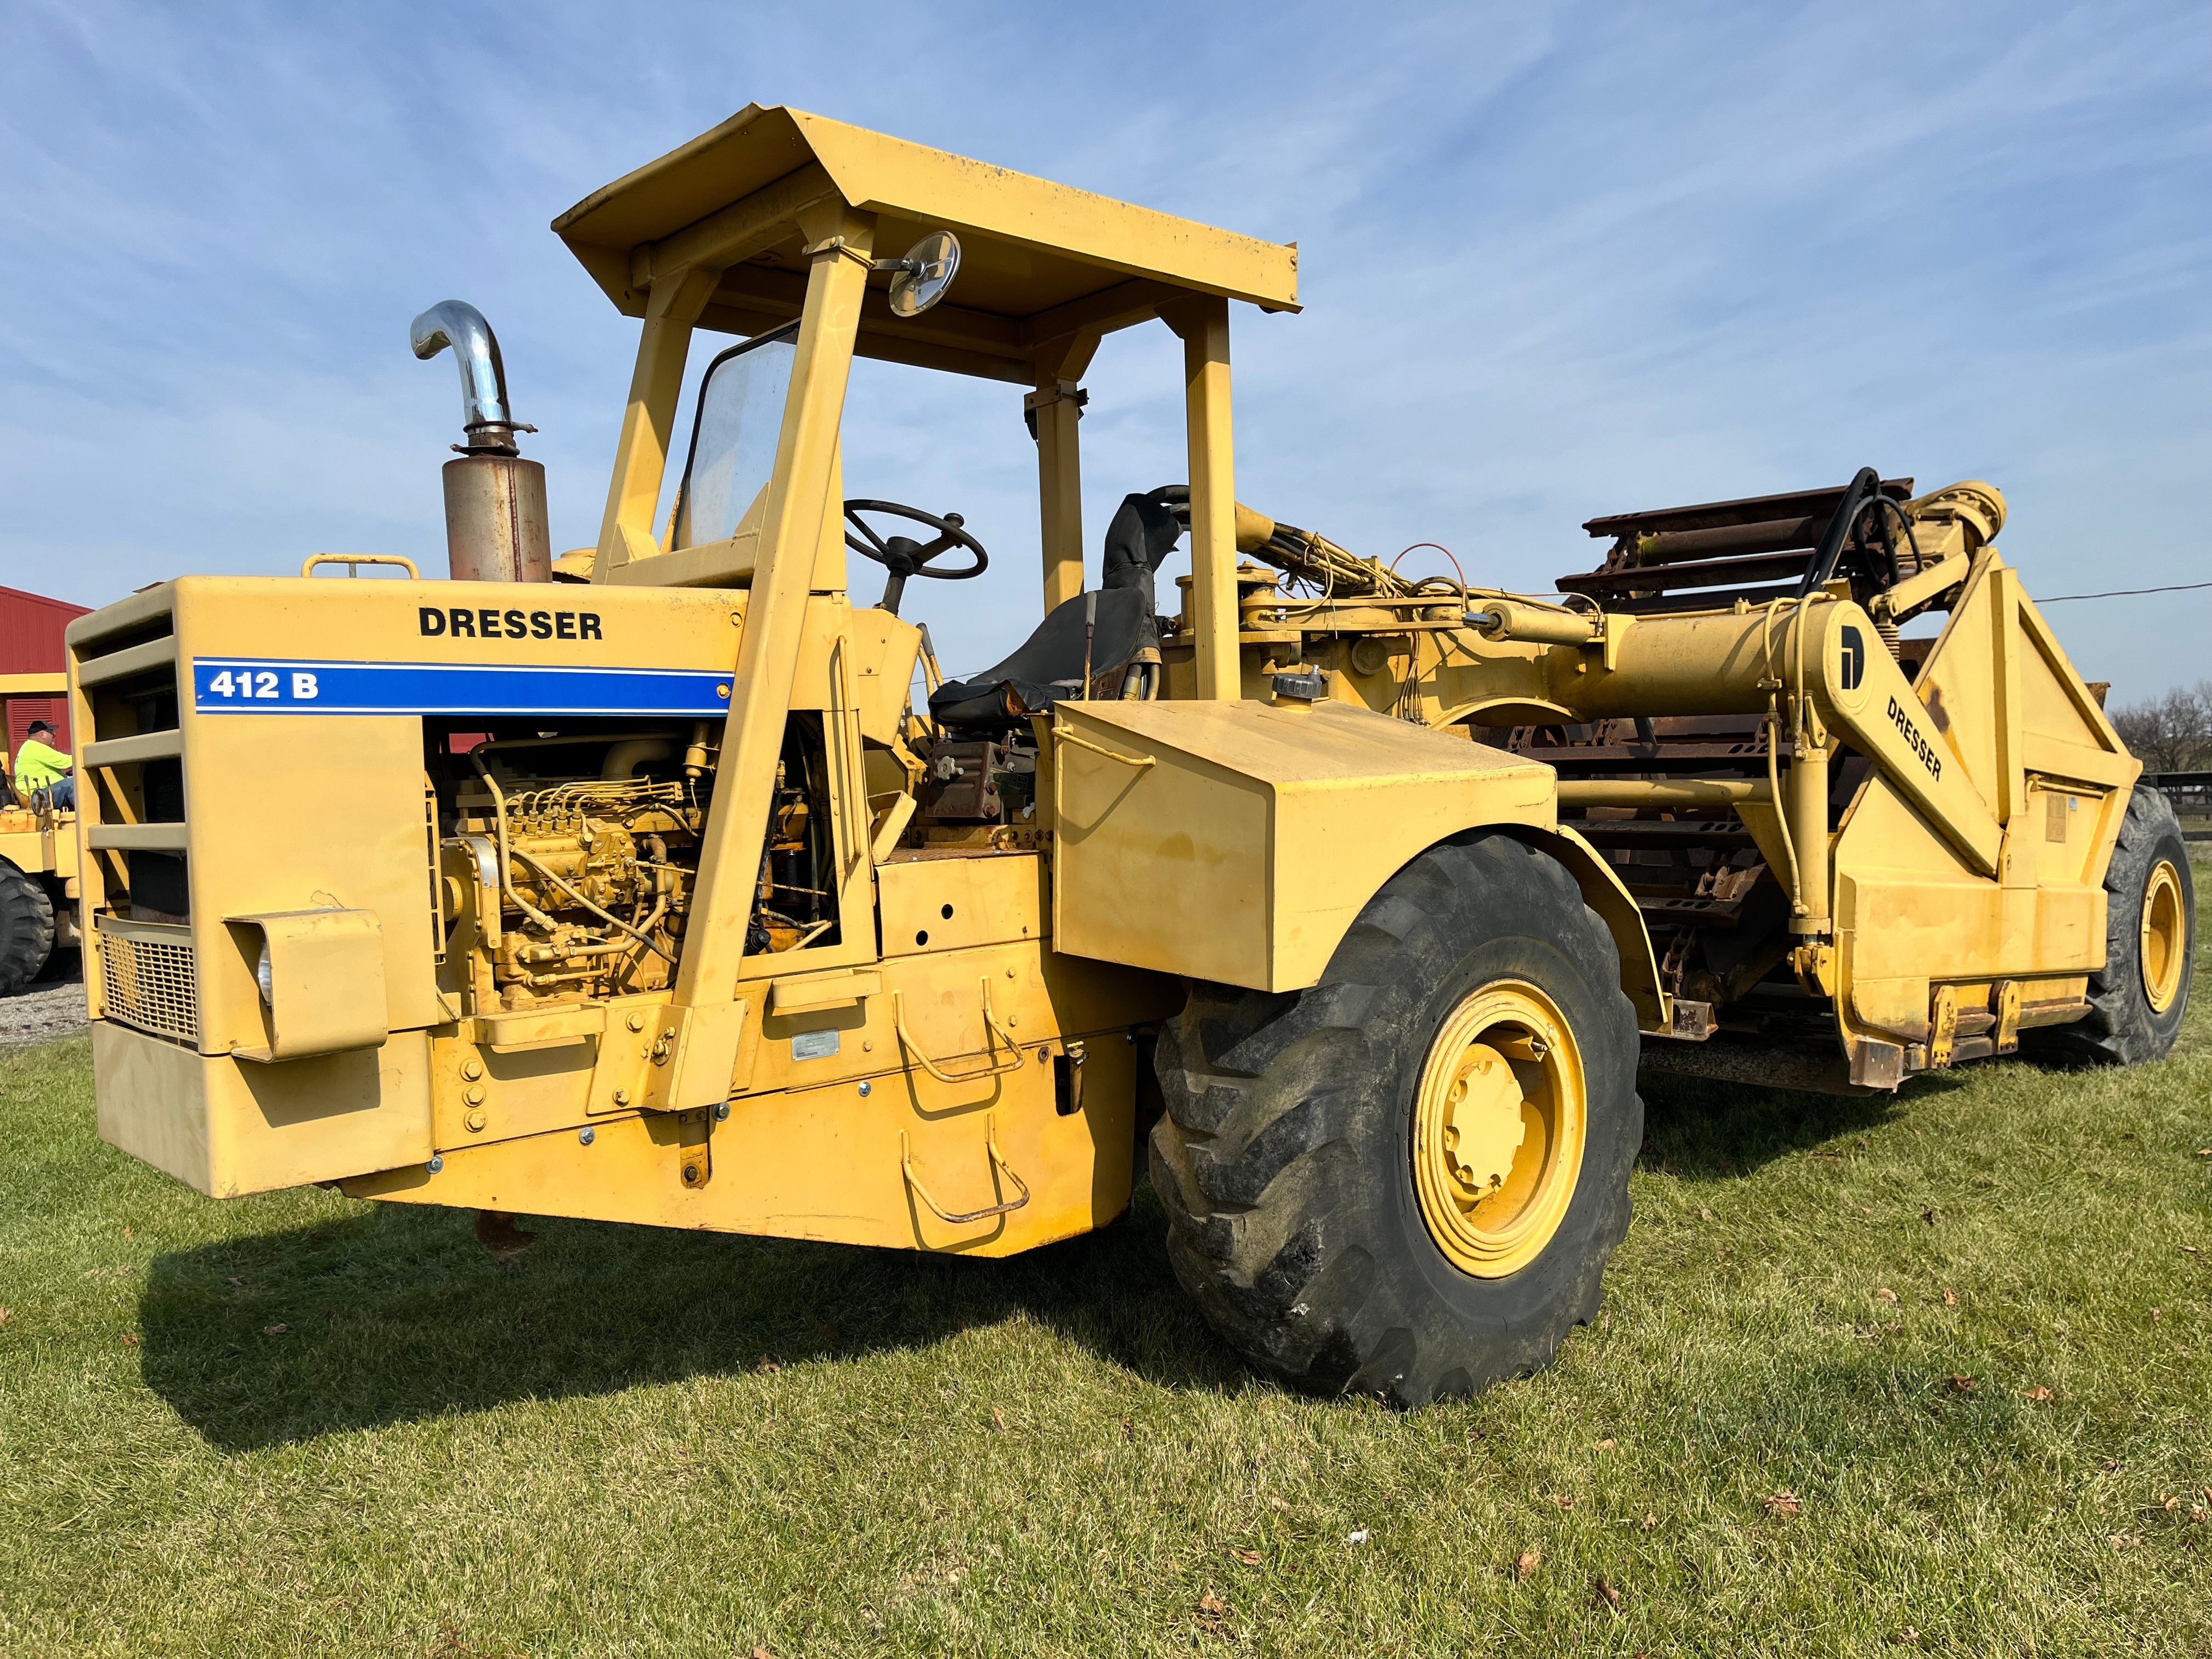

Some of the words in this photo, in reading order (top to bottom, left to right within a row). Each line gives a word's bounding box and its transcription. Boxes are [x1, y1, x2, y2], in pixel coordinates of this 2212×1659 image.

[419, 607, 603, 640] DRESSER
[210, 671, 279, 698] 412
[292, 673, 319, 699] B
[1887, 695, 1942, 782] DRESSER
